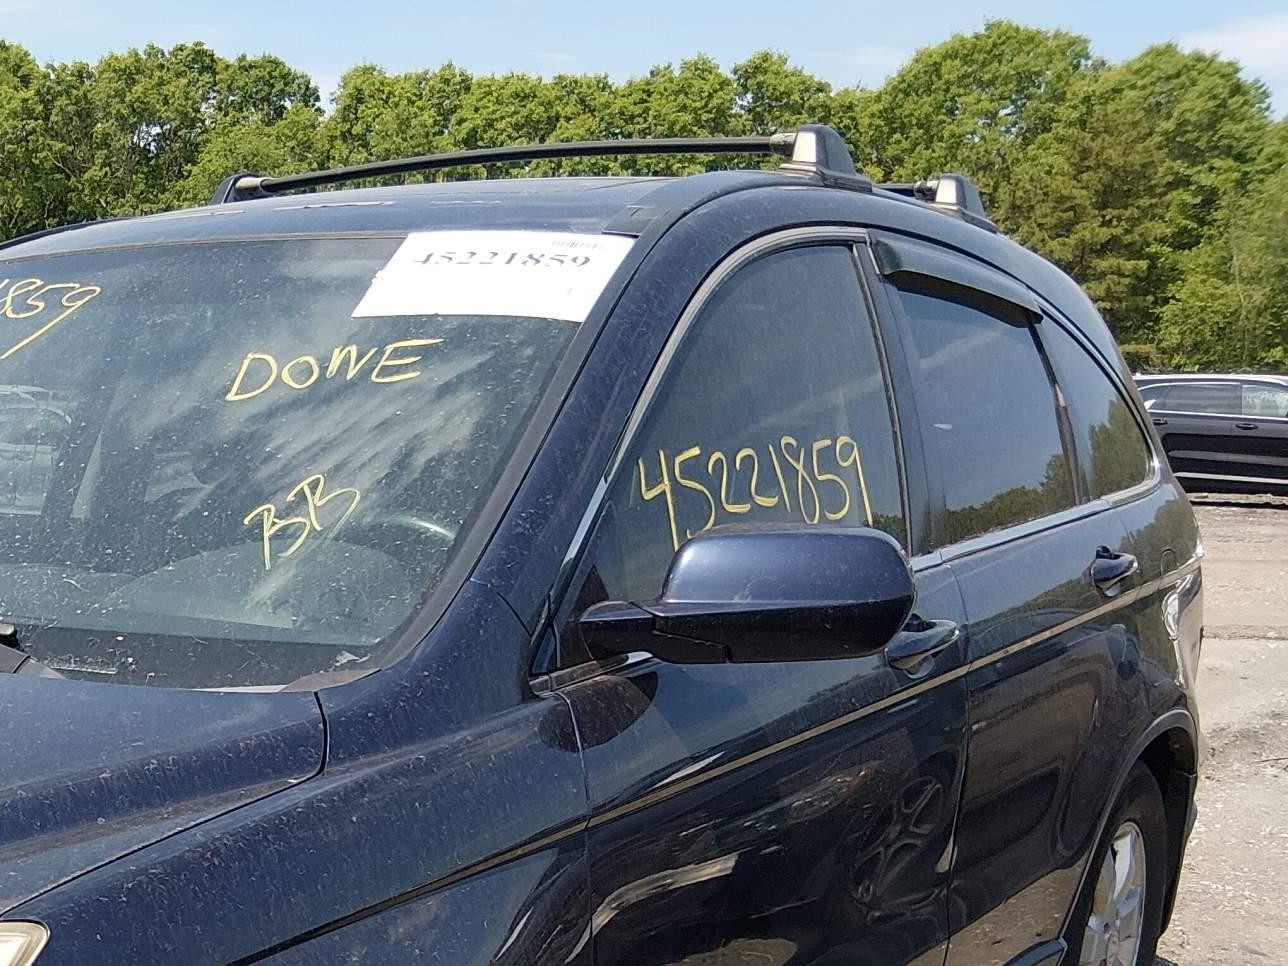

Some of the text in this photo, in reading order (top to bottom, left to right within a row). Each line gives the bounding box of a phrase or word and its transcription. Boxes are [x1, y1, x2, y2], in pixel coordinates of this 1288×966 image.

[413, 251, 591, 268] 45221859
[224, 338, 436, 402] DONE
[638, 434, 874, 552] 45221859
